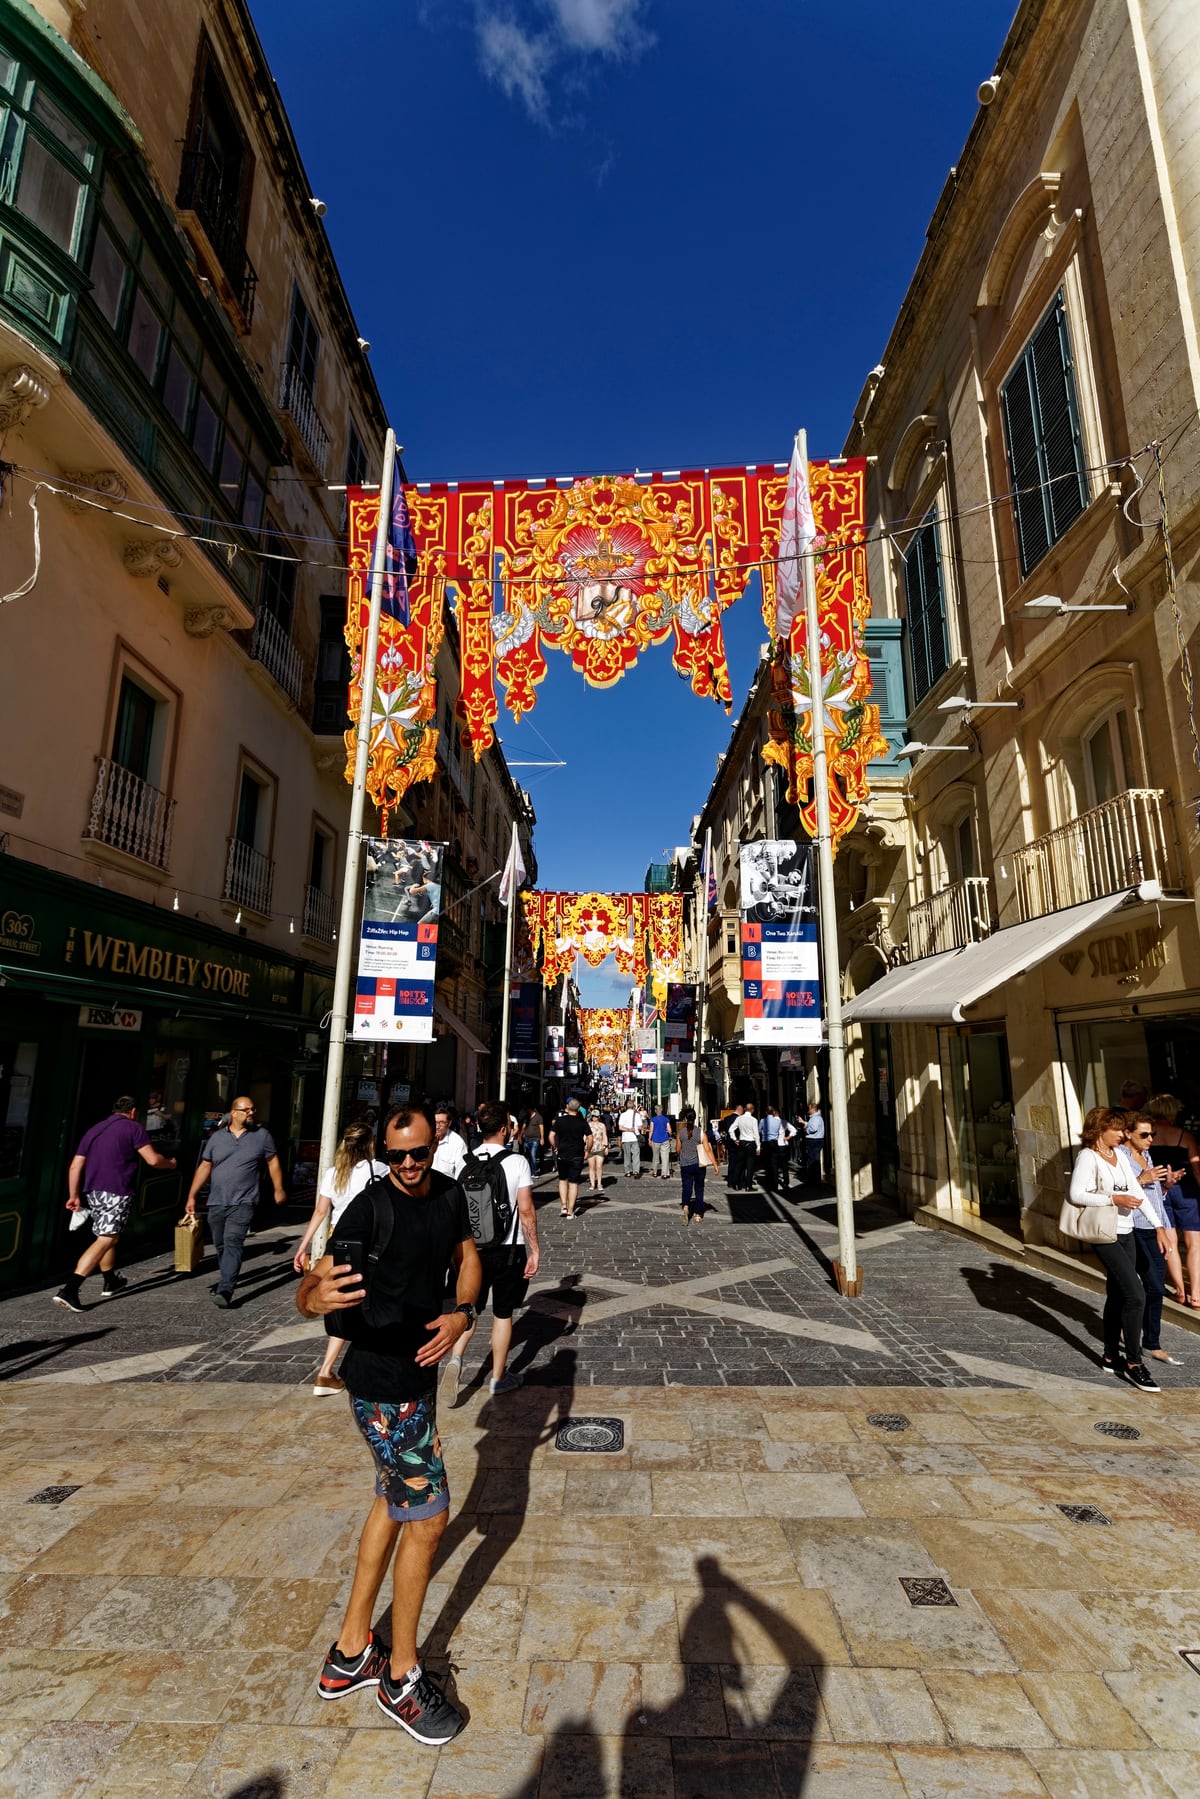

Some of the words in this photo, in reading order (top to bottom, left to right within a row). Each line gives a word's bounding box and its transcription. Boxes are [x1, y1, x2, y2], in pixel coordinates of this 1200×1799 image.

[7, 919, 29, 937] 305
[66, 927, 76, 963] THE
[422, 945, 431, 958] B
[748, 946, 756, 957] B
[83, 930, 200, 987] WEMBLEY
[201, 961, 251, 999] STORE
[87, 1008, 121, 1026] HSBC
[469, 1196, 481, 1239] OAKLEY
[397, 1696, 422, 1724] N
